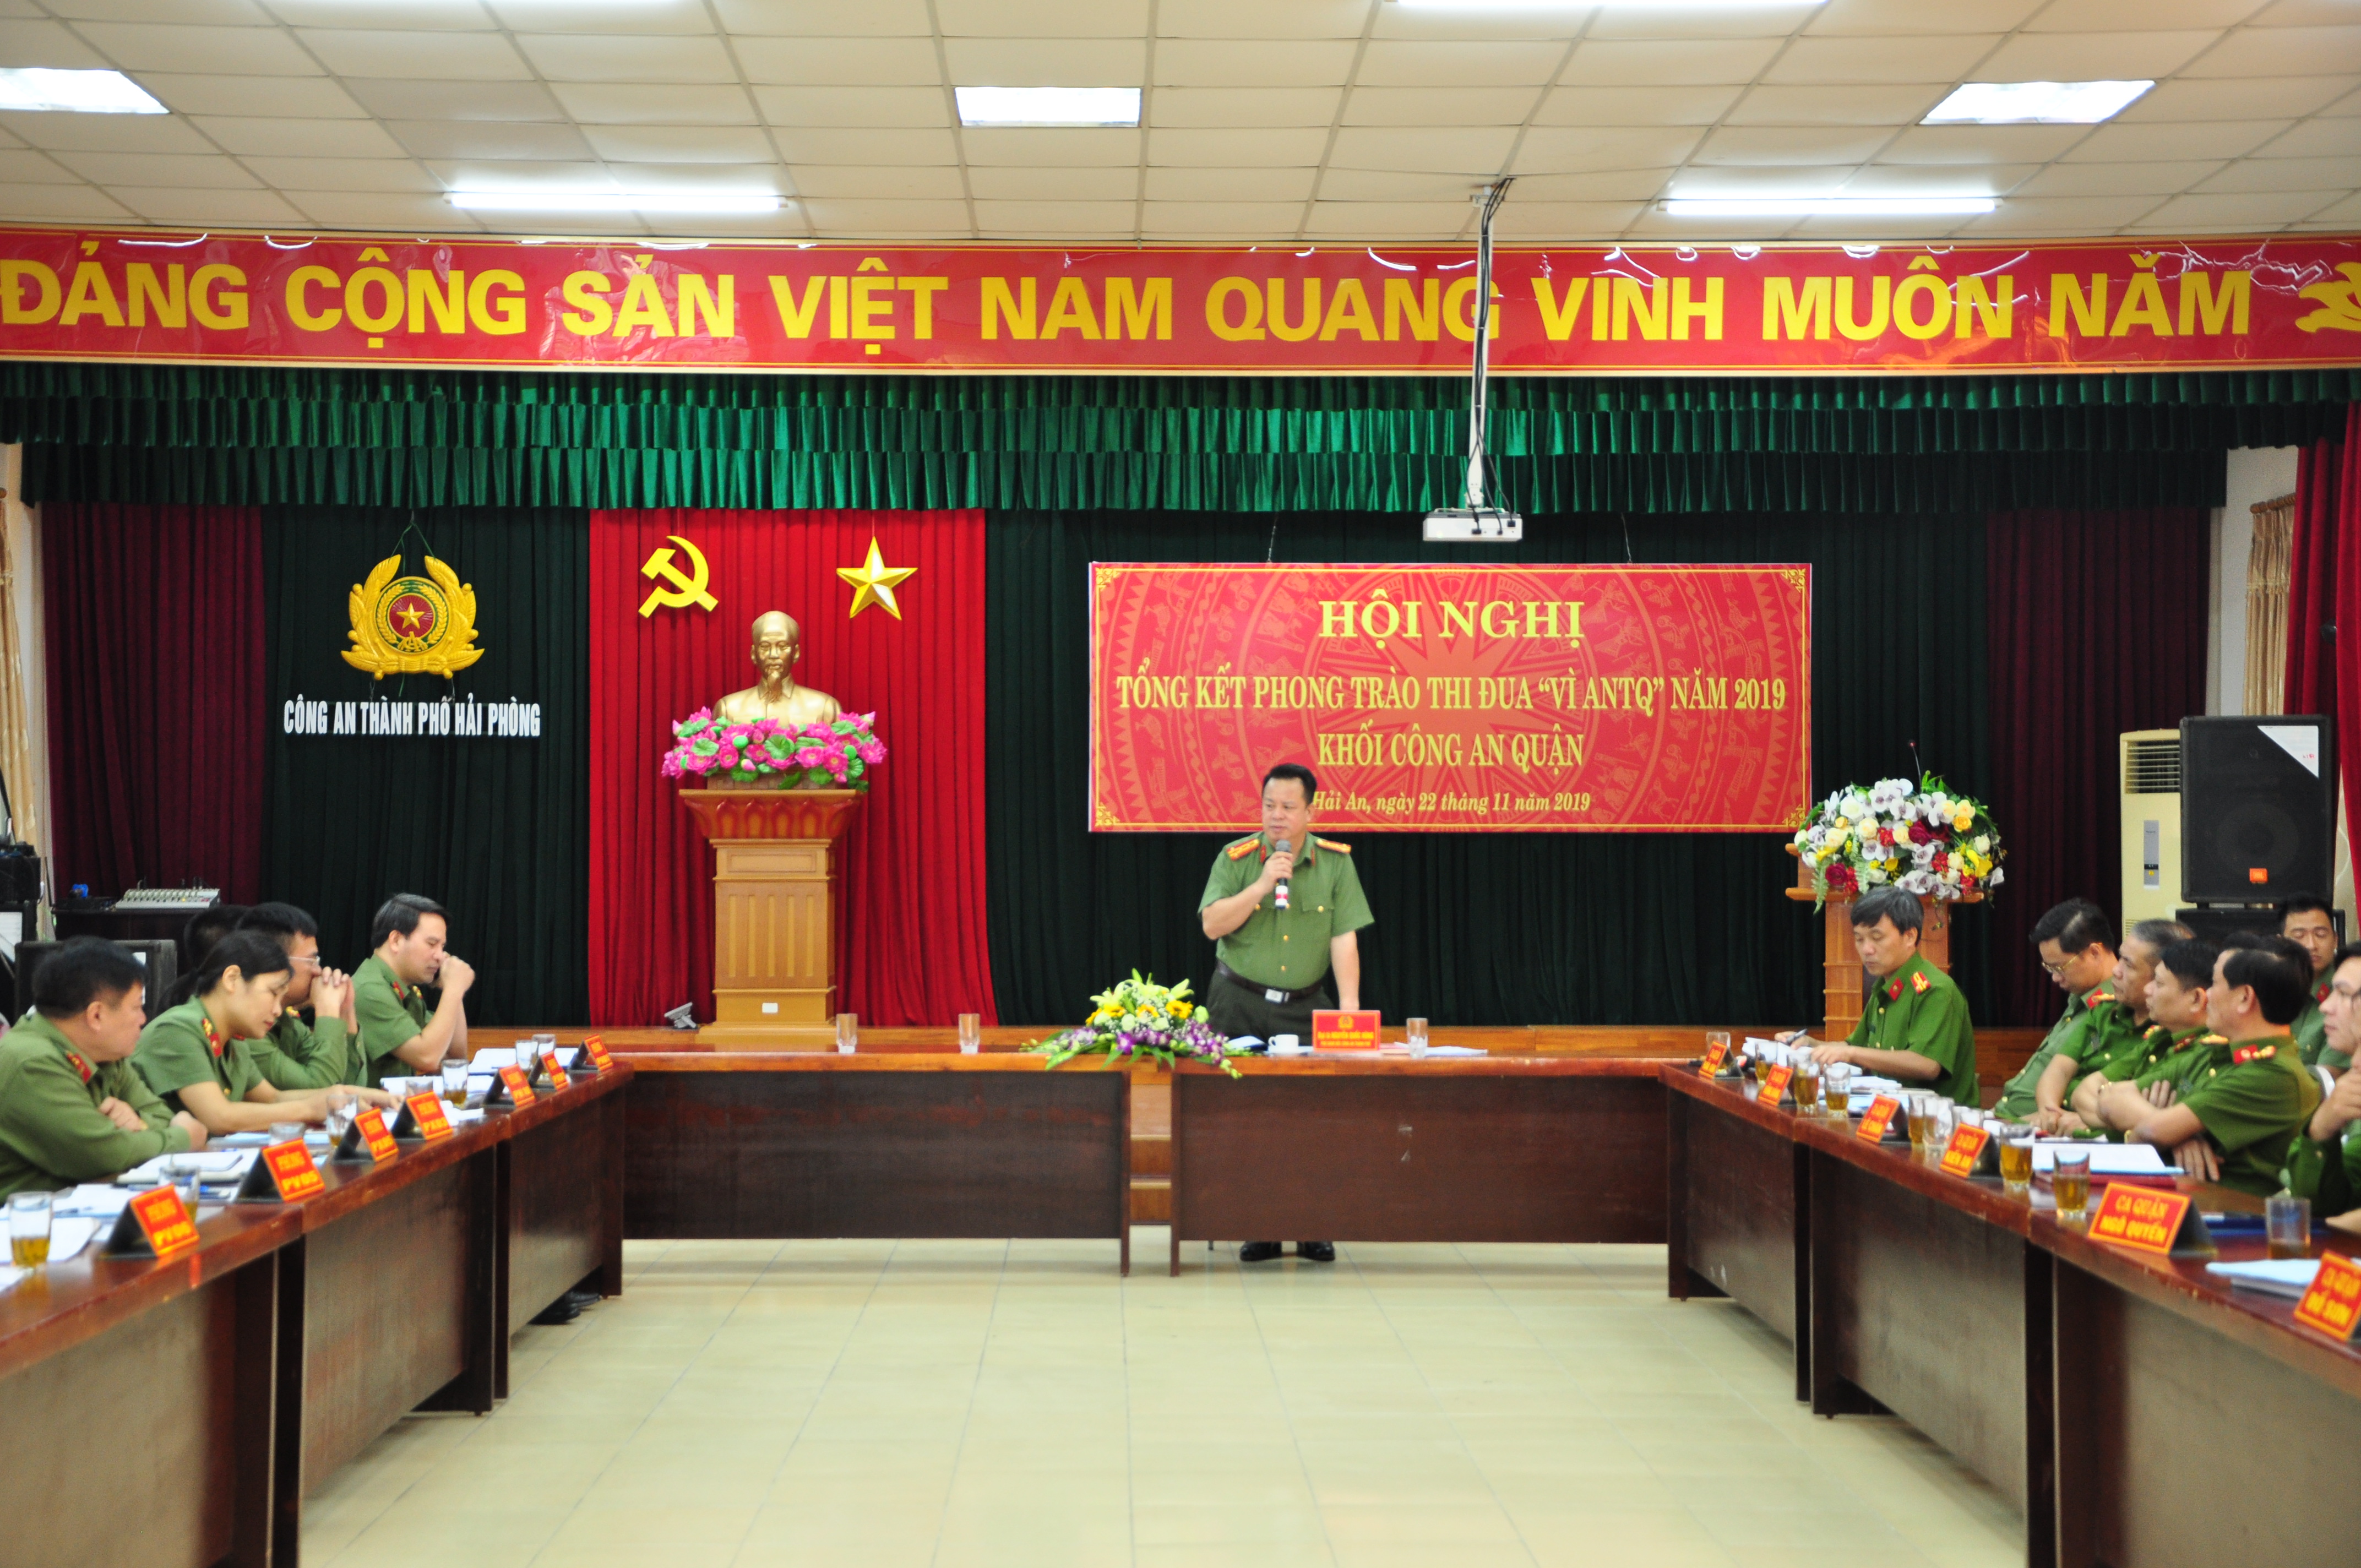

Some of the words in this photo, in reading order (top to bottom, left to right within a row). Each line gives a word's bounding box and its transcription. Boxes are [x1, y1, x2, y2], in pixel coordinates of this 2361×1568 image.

[0, 241, 248, 329] ĐẢNG
[286, 247, 526, 349] CỘNG
[562, 254, 735, 339] SẢN
[768, 257, 948, 354] VIỆT
[981, 276, 1172, 340] NAM
[1206, 277, 1499, 341] QUANG
[1532, 277, 1723, 340] VINH
[1763, 256, 2012, 340] MUÔN
[2049, 254, 2251, 336] NĂM
[1319, 589, 1422, 649] HỘI
[1439, 601, 1584, 648] NGHỊ
[1117, 658, 1188, 708] TỔNG
[1196, 663, 1246, 708] KẾT
[1254, 676, 1344, 709] PHONG
[1351, 667, 1421, 709] TRÀO
[1427, 677, 1471, 709] THI
[1478, 677, 1533, 709] “VÌ
[1479, 677, 1533, 709] ĐUA
[1583, 677, 1664, 716] ANTQ”
[1672, 667, 1728, 709] NĂM
[1735, 679, 1785, 709] 2019
[284, 694, 328, 734] CÔNG
[333, 702, 356, 734] AN
[360, 696, 412, 734] THÀNH
[418, 695, 453, 736] PHỐ
[455, 693, 482, 736] HẢI
[488, 696, 540, 737] PHÒNG
[1319, 718, 1383, 766] KHỐI
[1391, 723, 1462, 766] CÔNG
[1469, 734, 1504, 766] AN
[1512, 724, 1584, 775] QUẬN
[1313, 790, 1341, 810] Hải
[1345, 791, 1372, 814] An,
[1377, 792, 1414, 815] ngày
[1419, 793, 1437, 810] 22
[1441, 791, 1488, 815] tháng
[1494, 794, 1509, 810] 11
[1516, 794, 1549, 810] năm
[1554, 793, 1591, 811] 2019
